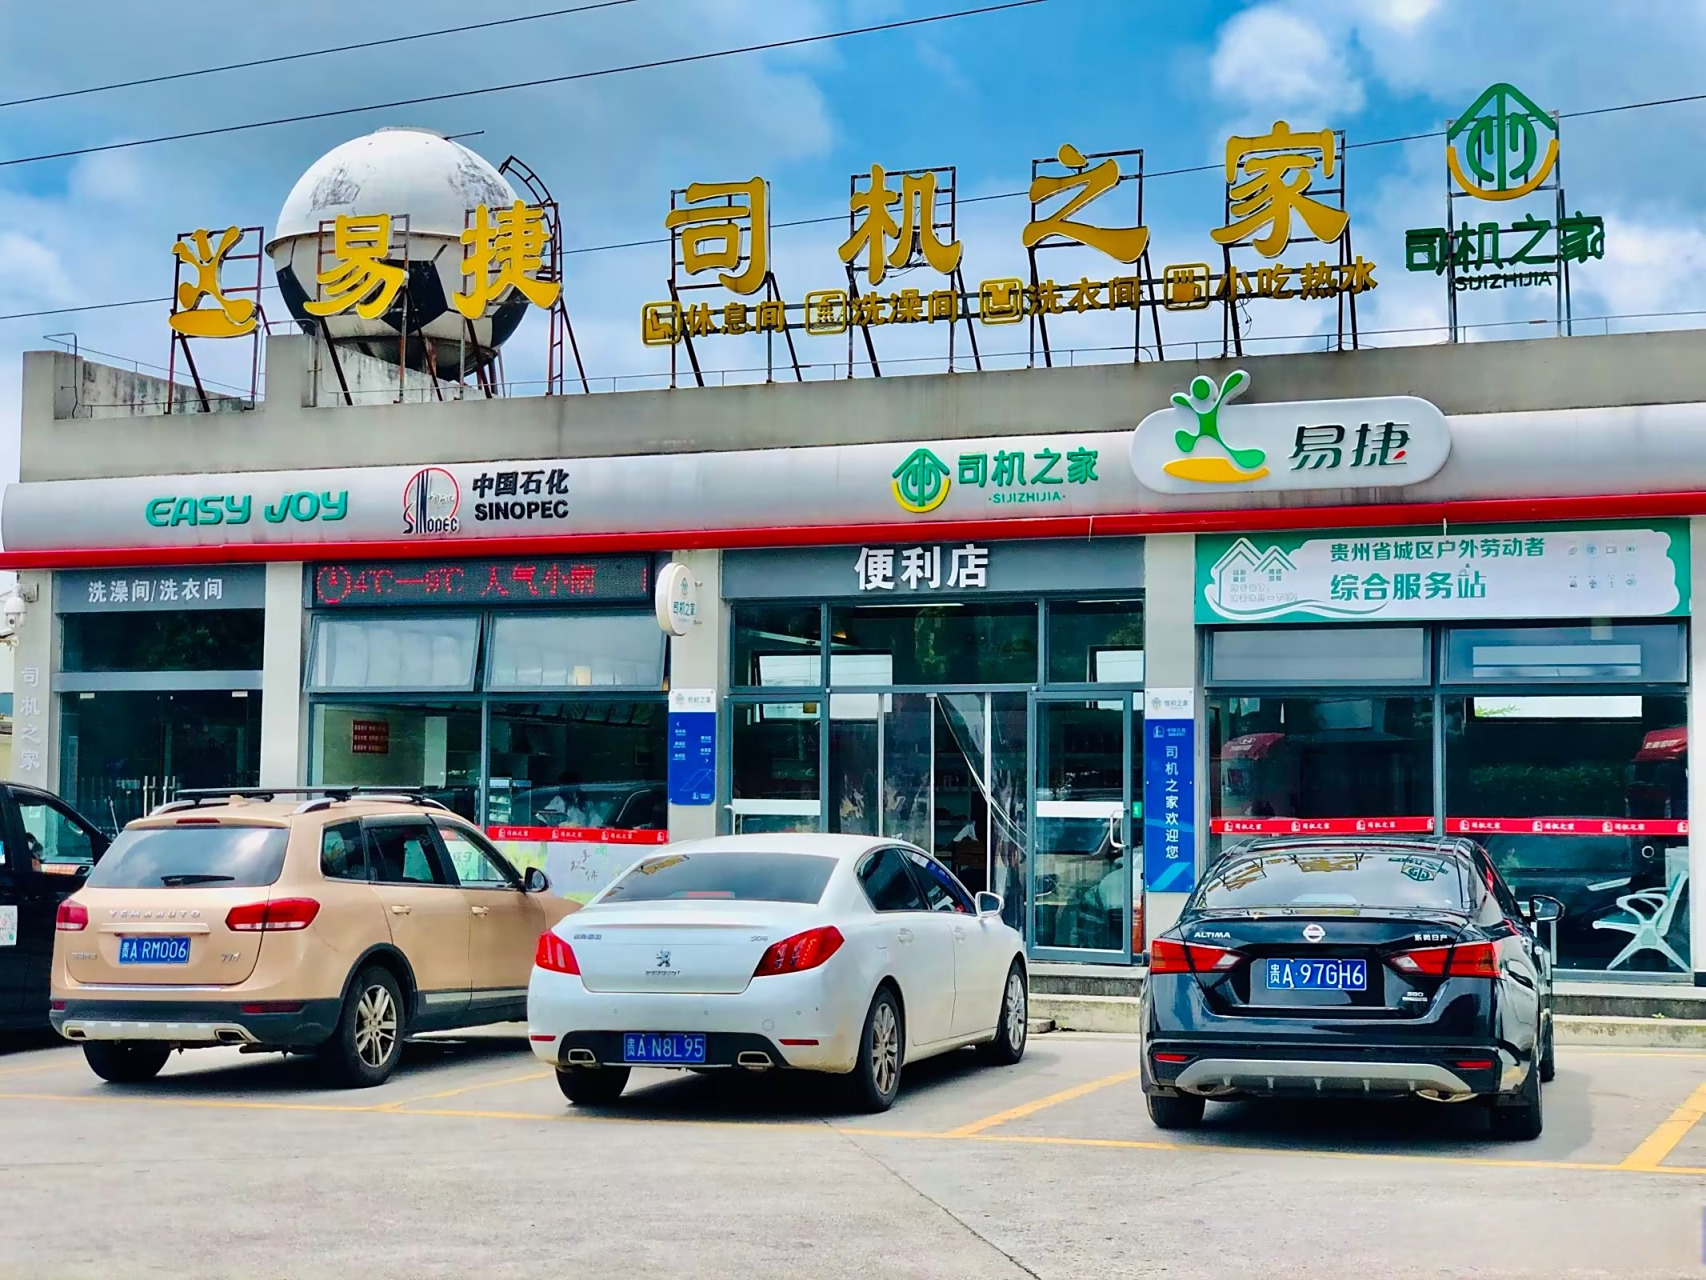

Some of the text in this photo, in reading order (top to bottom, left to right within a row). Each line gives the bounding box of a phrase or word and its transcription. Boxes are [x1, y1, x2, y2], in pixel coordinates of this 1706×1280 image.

[665, 119, 1350, 295] 司机之家
[303, 198, 561, 320] 易捷
[1405, 210, 1606, 276] 司机之家
[1026, 275, 1140, 317] 洗衣间
[1216, 255, 1379, 303] 小吃热水
[686, 301, 785, 337] 休息间
[850, 288, 958, 327] 洗澡间
[1288, 421, 1413, 471] 易捷
[472, 468, 570, 499] 中国石化
[957, 447, 1099, 488] 司机之家
[145, 489, 349, 527] EASY JOY
[474, 500, 569, 521] SINOPEC
[853, 544, 991, 592] 便利店
[1329, 537, 1546, 563] 贵州省城区户外劳动者
[88, 577, 223, 604] 洗澡间/洗衣间
[1330, 568, 1488, 601] 综合服务站
[20, 667, 42, 772] 司机之家
[1165, 745, 1179, 859] 司机之家欢迎您
